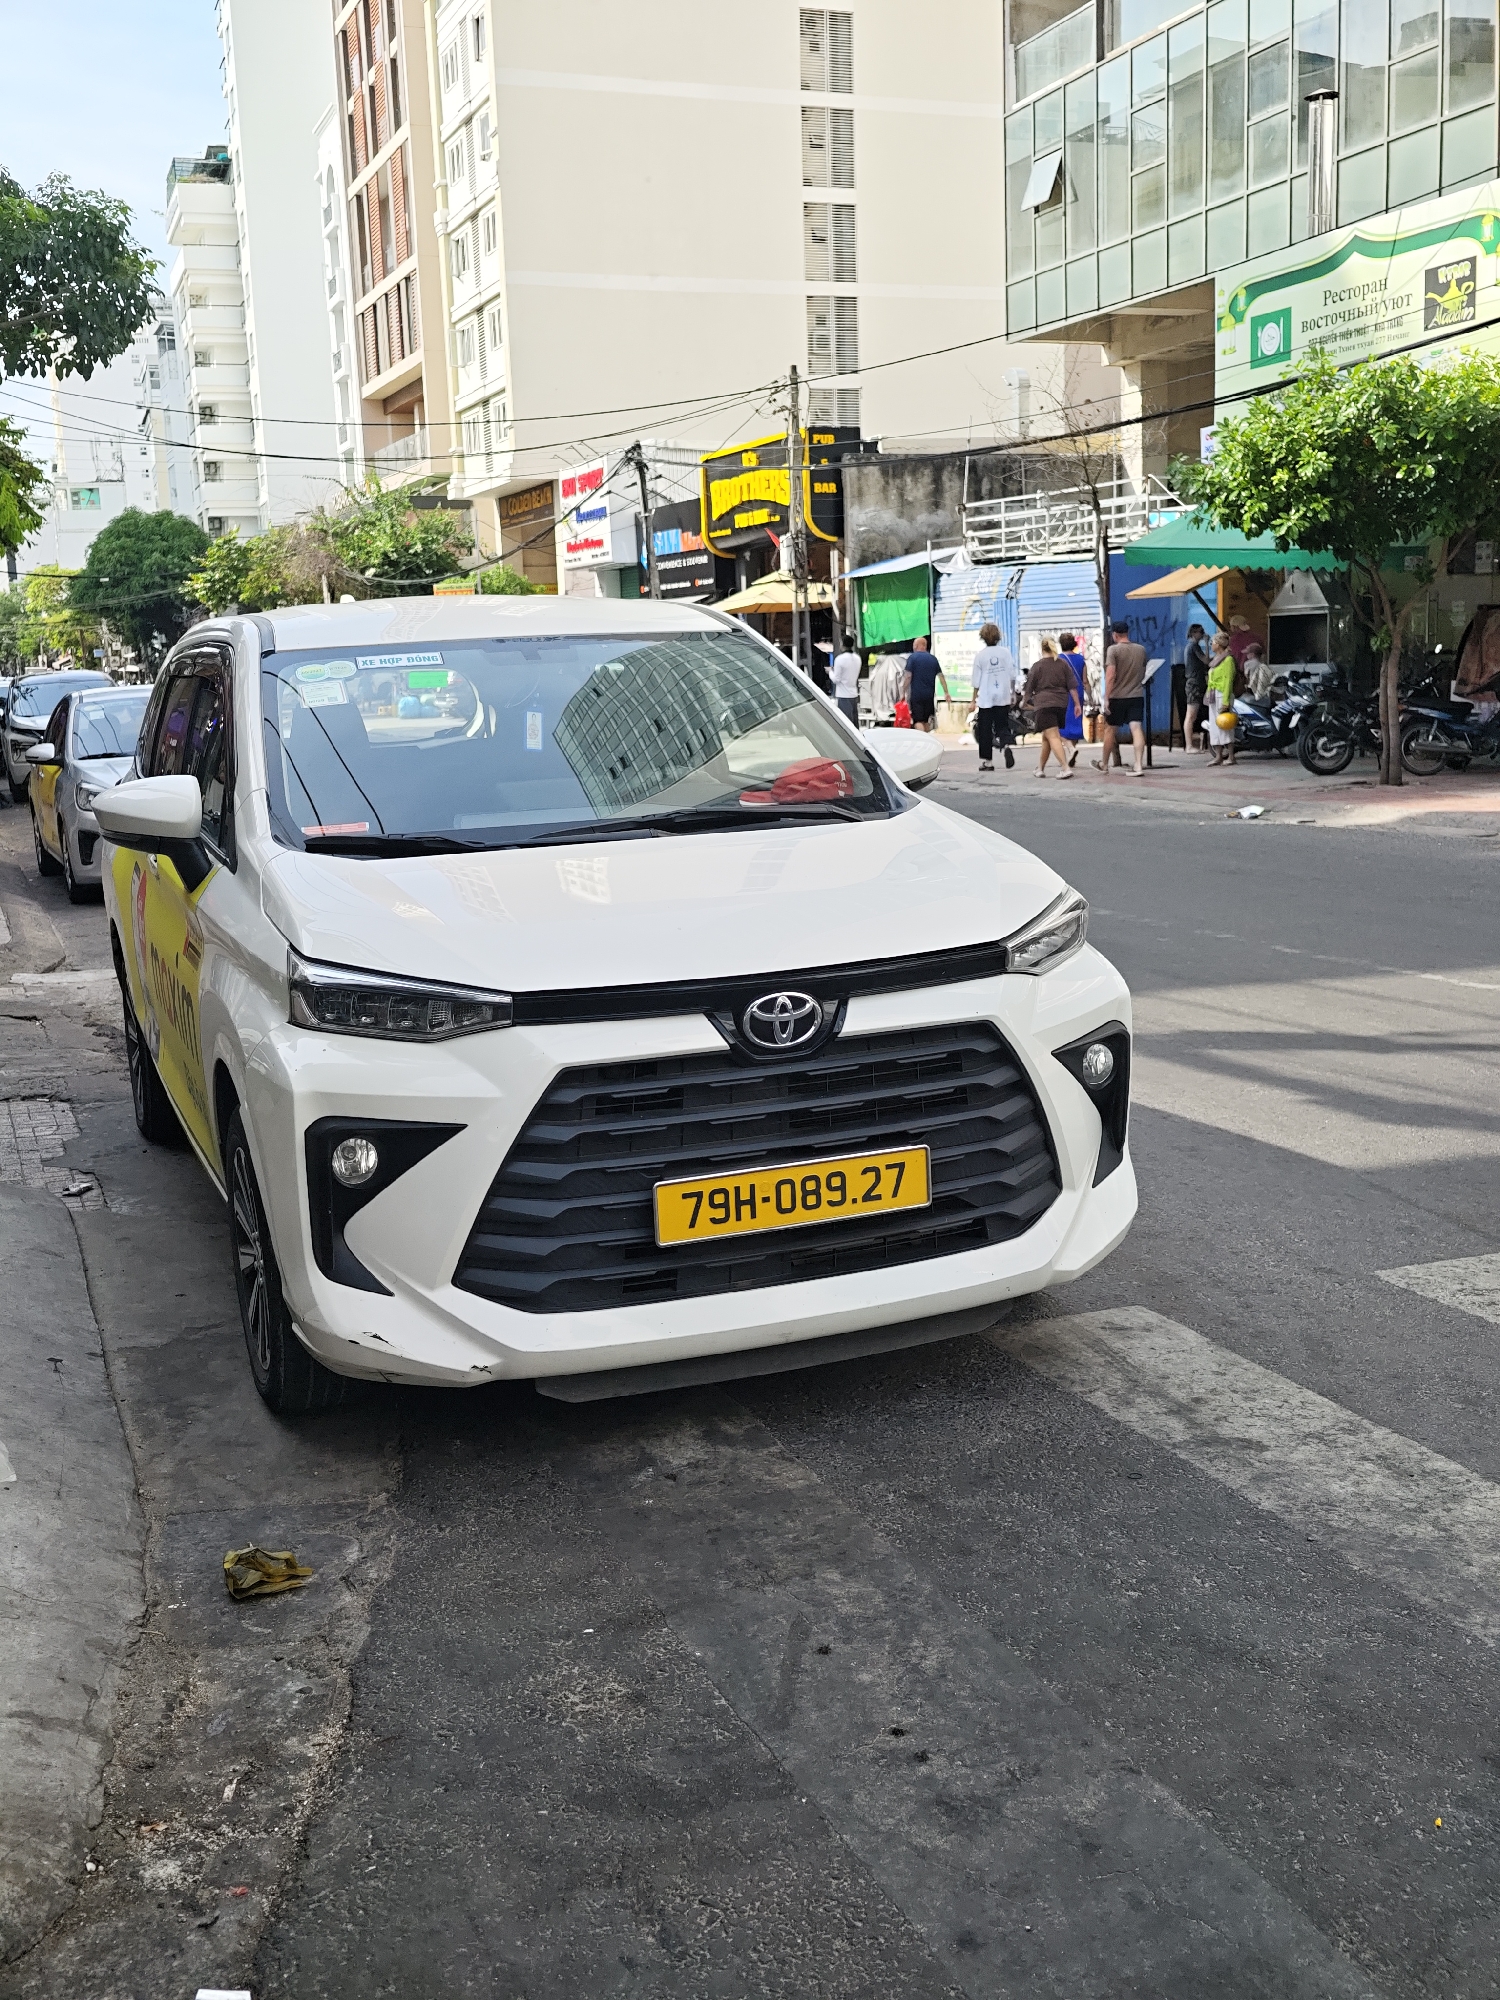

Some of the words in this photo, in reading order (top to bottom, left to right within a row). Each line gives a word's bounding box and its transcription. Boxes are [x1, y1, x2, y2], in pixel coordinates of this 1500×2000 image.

[1322, 277, 1388, 307] Ресторан
[1301, 297, 1379, 333] восточный
[1381, 293, 1413, 317] уют
[812, 434, 835, 444] PUB
[710, 469, 791, 521] BROTHERS
[813, 482, 837, 493] BAR
[151, 941, 199, 1067] maxim
[681, 1161, 906, 1229] 79H-089.27
